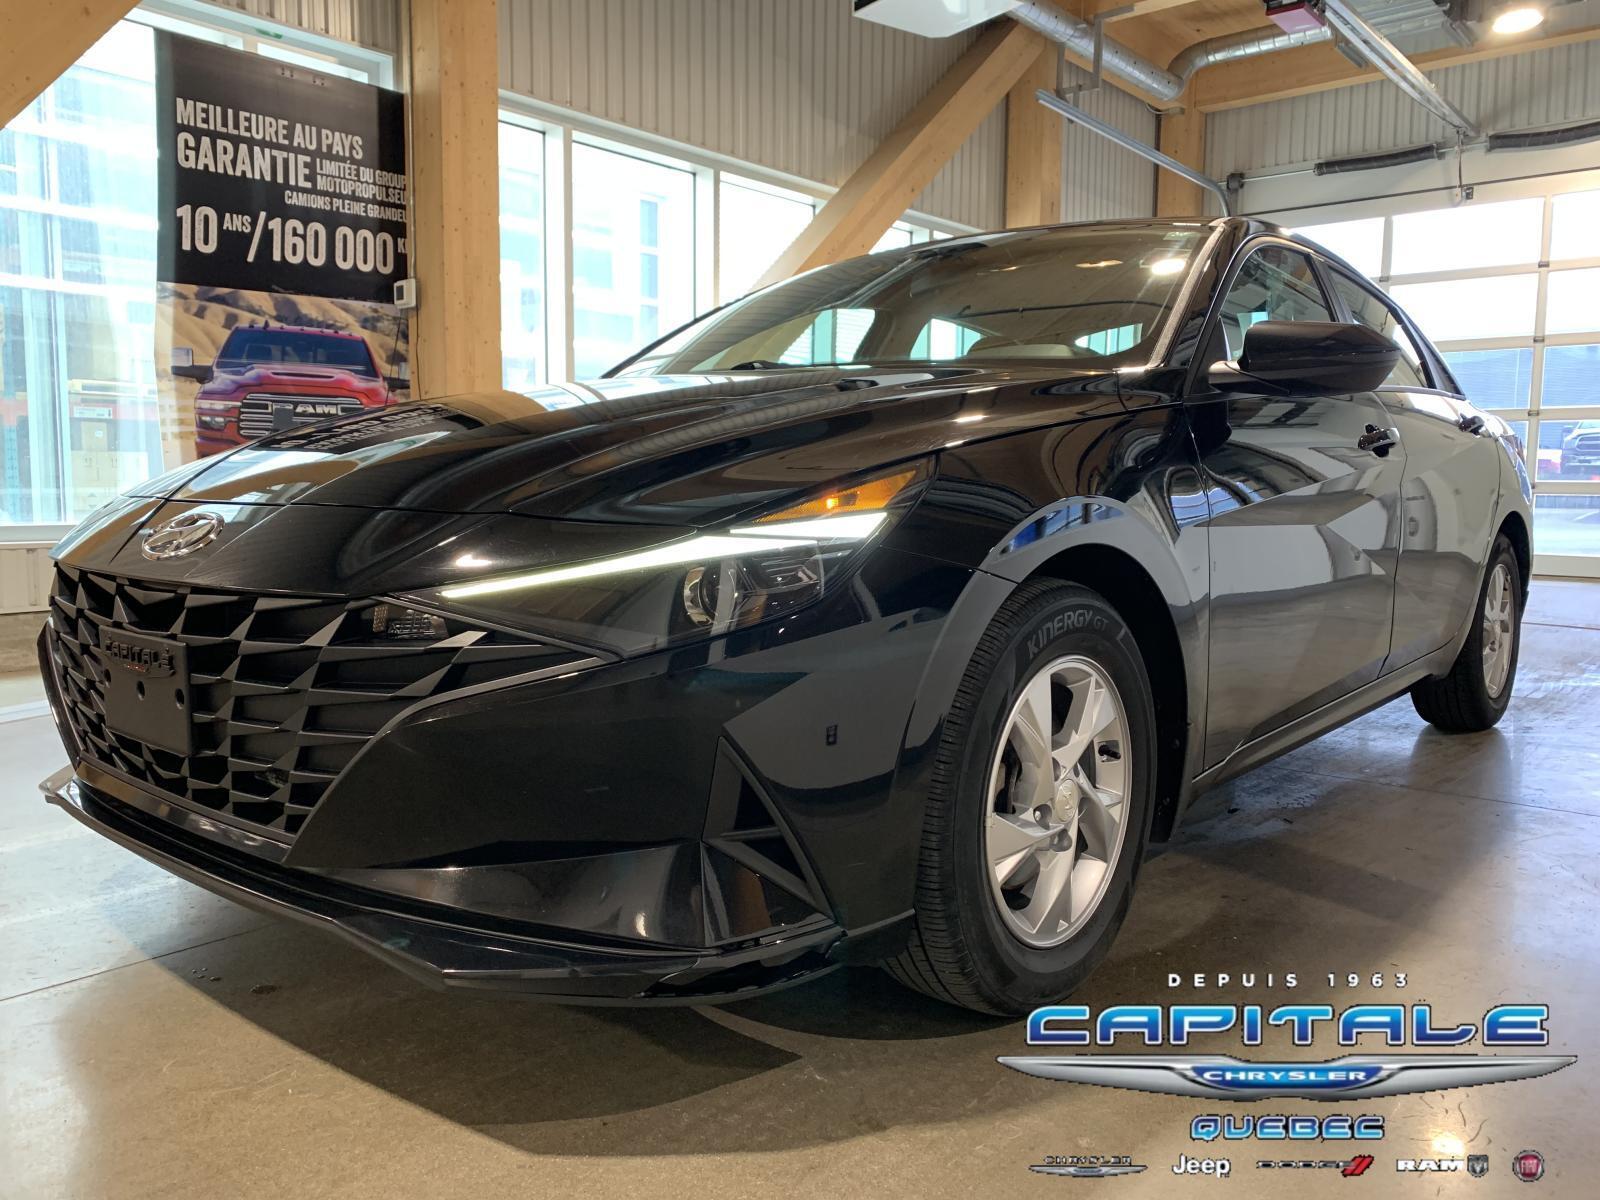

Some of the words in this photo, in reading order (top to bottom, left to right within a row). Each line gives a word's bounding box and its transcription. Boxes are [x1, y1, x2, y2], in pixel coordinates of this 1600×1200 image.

[176, 97, 289, 145] MEILLEURE
[293, 123, 317, 150] AU
[321, 128, 363, 160] PAYS
[176, 132, 312, 188] GARANTIE
[316, 158, 357, 181] LIMITÉE
[360, 167, 374, 183] DU
[284, 190, 331, 211] CAMIONS
[333, 198, 366, 216] PLEINE
[176, 204, 218, 254] 10
[335, 225, 394, 275] 000
[1027, 609, 1093, 660] KINERGY
[1093, 615, 1110, 631] GT
